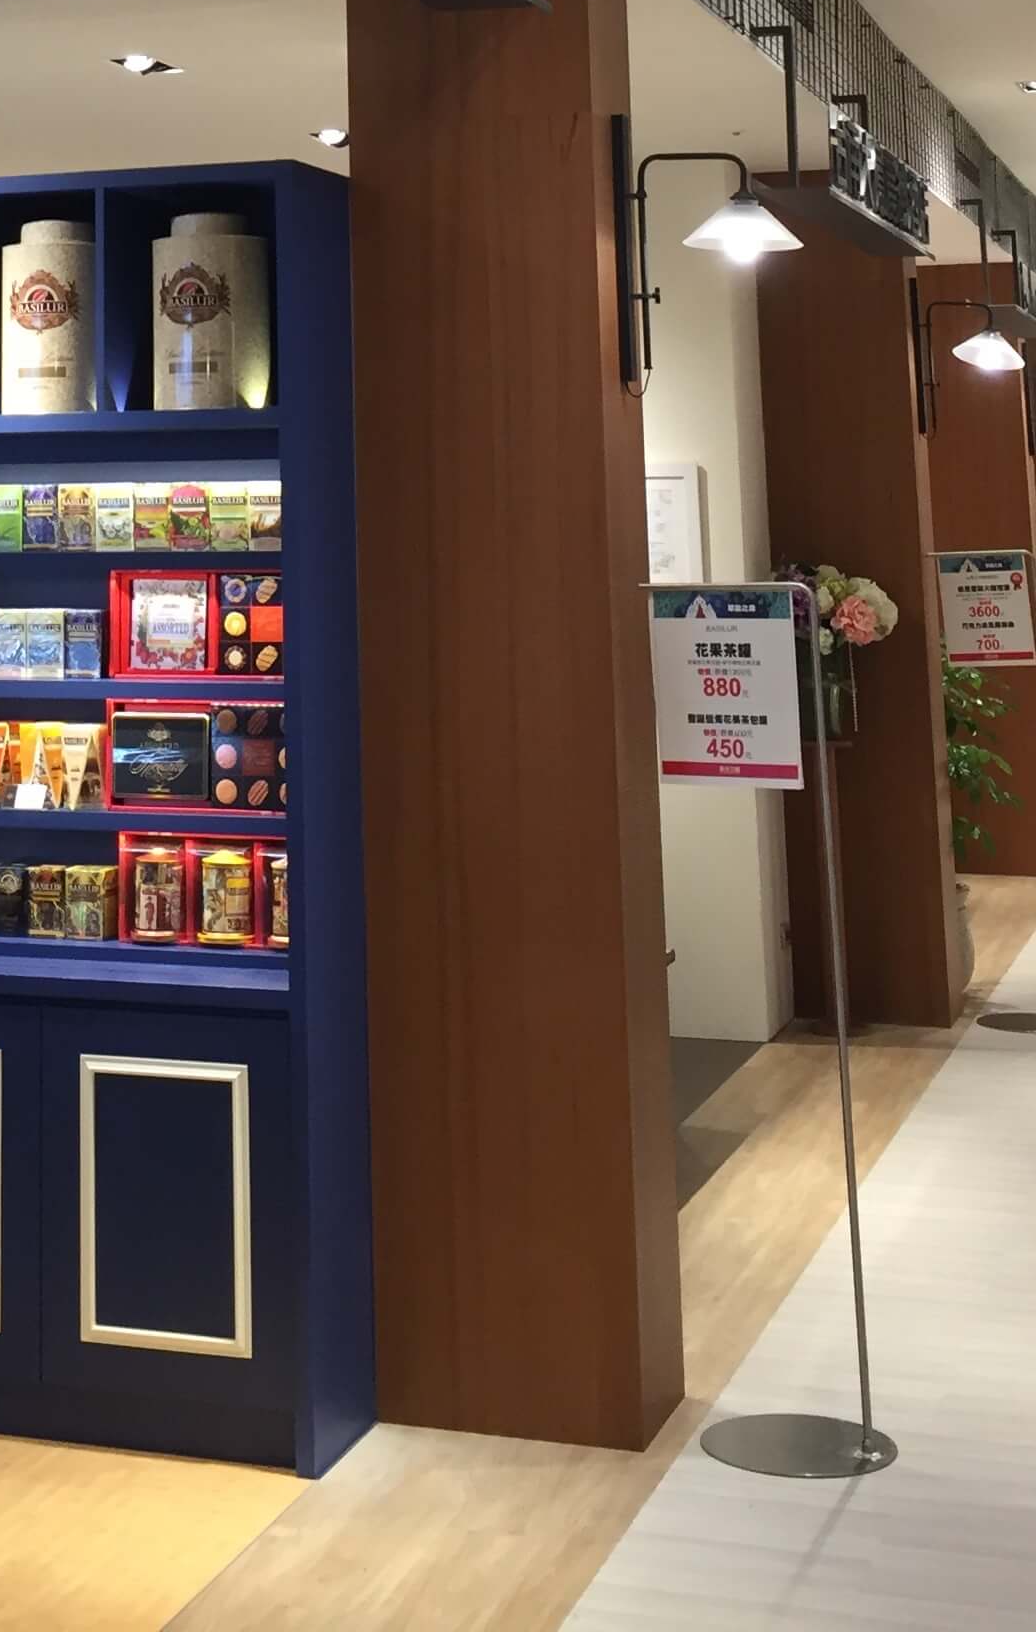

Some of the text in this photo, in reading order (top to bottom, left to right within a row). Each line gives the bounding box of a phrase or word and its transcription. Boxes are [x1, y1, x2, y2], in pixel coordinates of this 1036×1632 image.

[19, 303, 67, 314] BASILUR
[969, 605, 1001, 618] 3600
[695, 643, 752, 658] 花果茶罐
[976, 639, 1001, 651] 700
[703, 677, 741, 697] 880
[706, 738, 744, 758] 450
